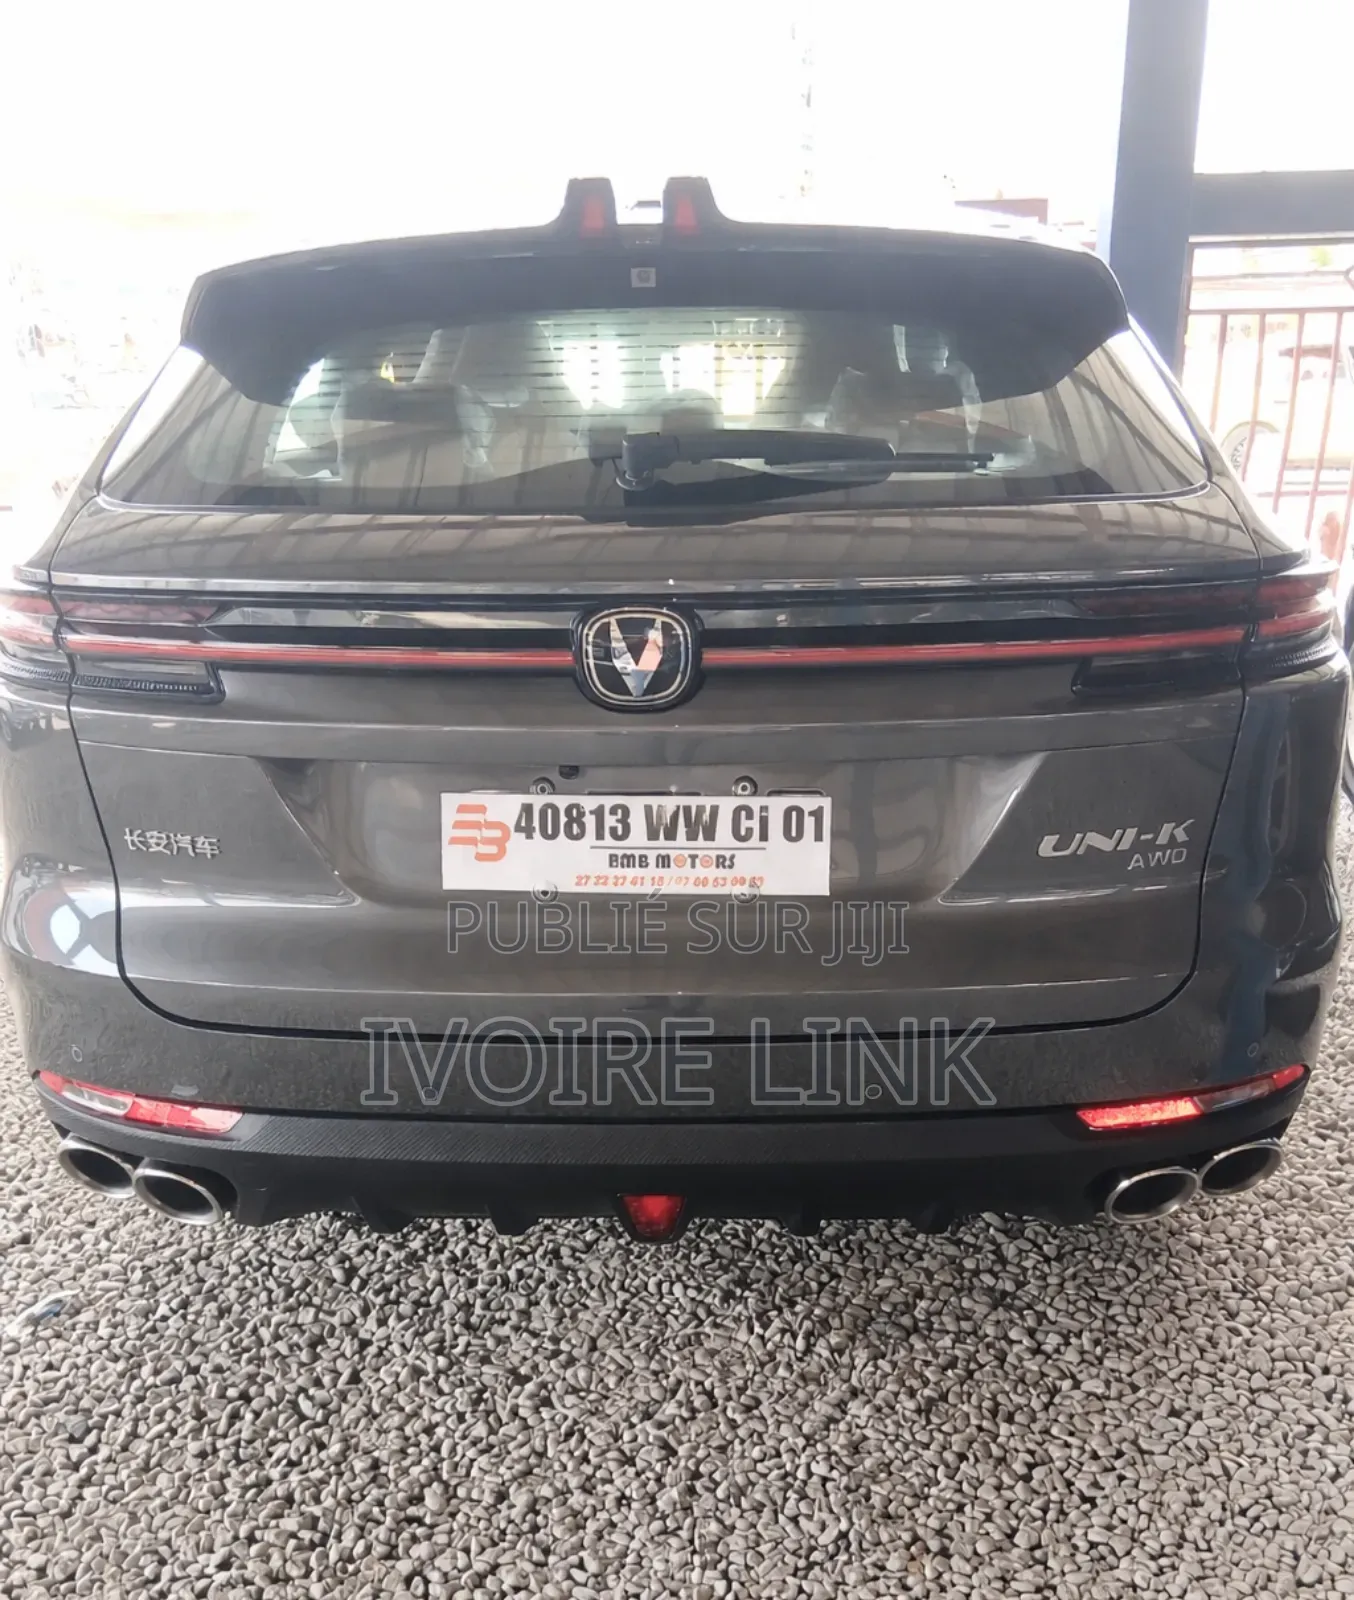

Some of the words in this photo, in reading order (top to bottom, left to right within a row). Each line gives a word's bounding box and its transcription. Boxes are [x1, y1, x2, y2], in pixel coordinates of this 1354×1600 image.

[514, 802, 631, 841] 40813
[644, 804, 720, 842] WW
[783, 805, 824, 842] 01
[124, 828, 220, 859] 长安汽车
[1038, 819, 1195, 857] UNI-K
[608, 853, 649, 868] BMB
[656, 854, 735, 869] MOTORS
[1127, 848, 1187, 870] AWD
